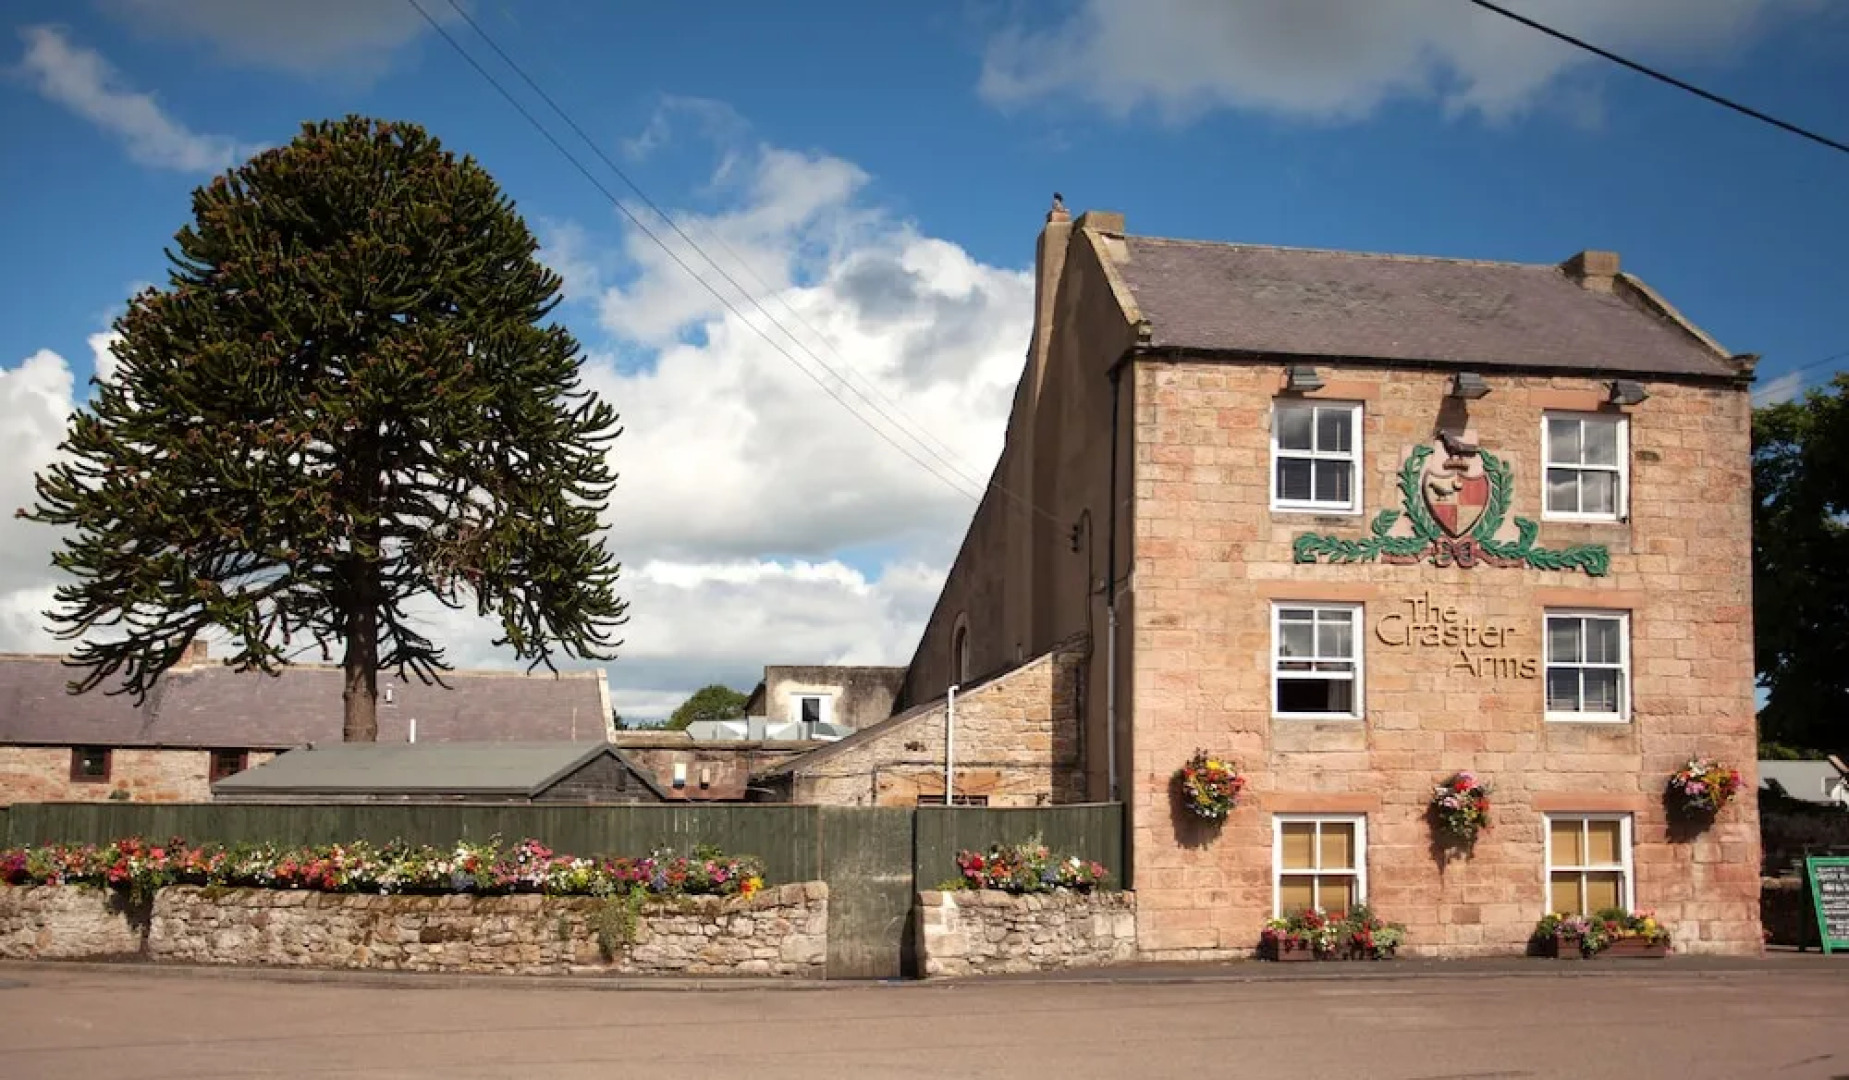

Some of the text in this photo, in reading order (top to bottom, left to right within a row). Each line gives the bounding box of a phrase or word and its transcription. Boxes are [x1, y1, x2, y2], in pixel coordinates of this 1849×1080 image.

[1402, 591, 1458, 624] The
[1375, 613, 1516, 648] Craster
[1450, 649, 1538, 680] Arms
